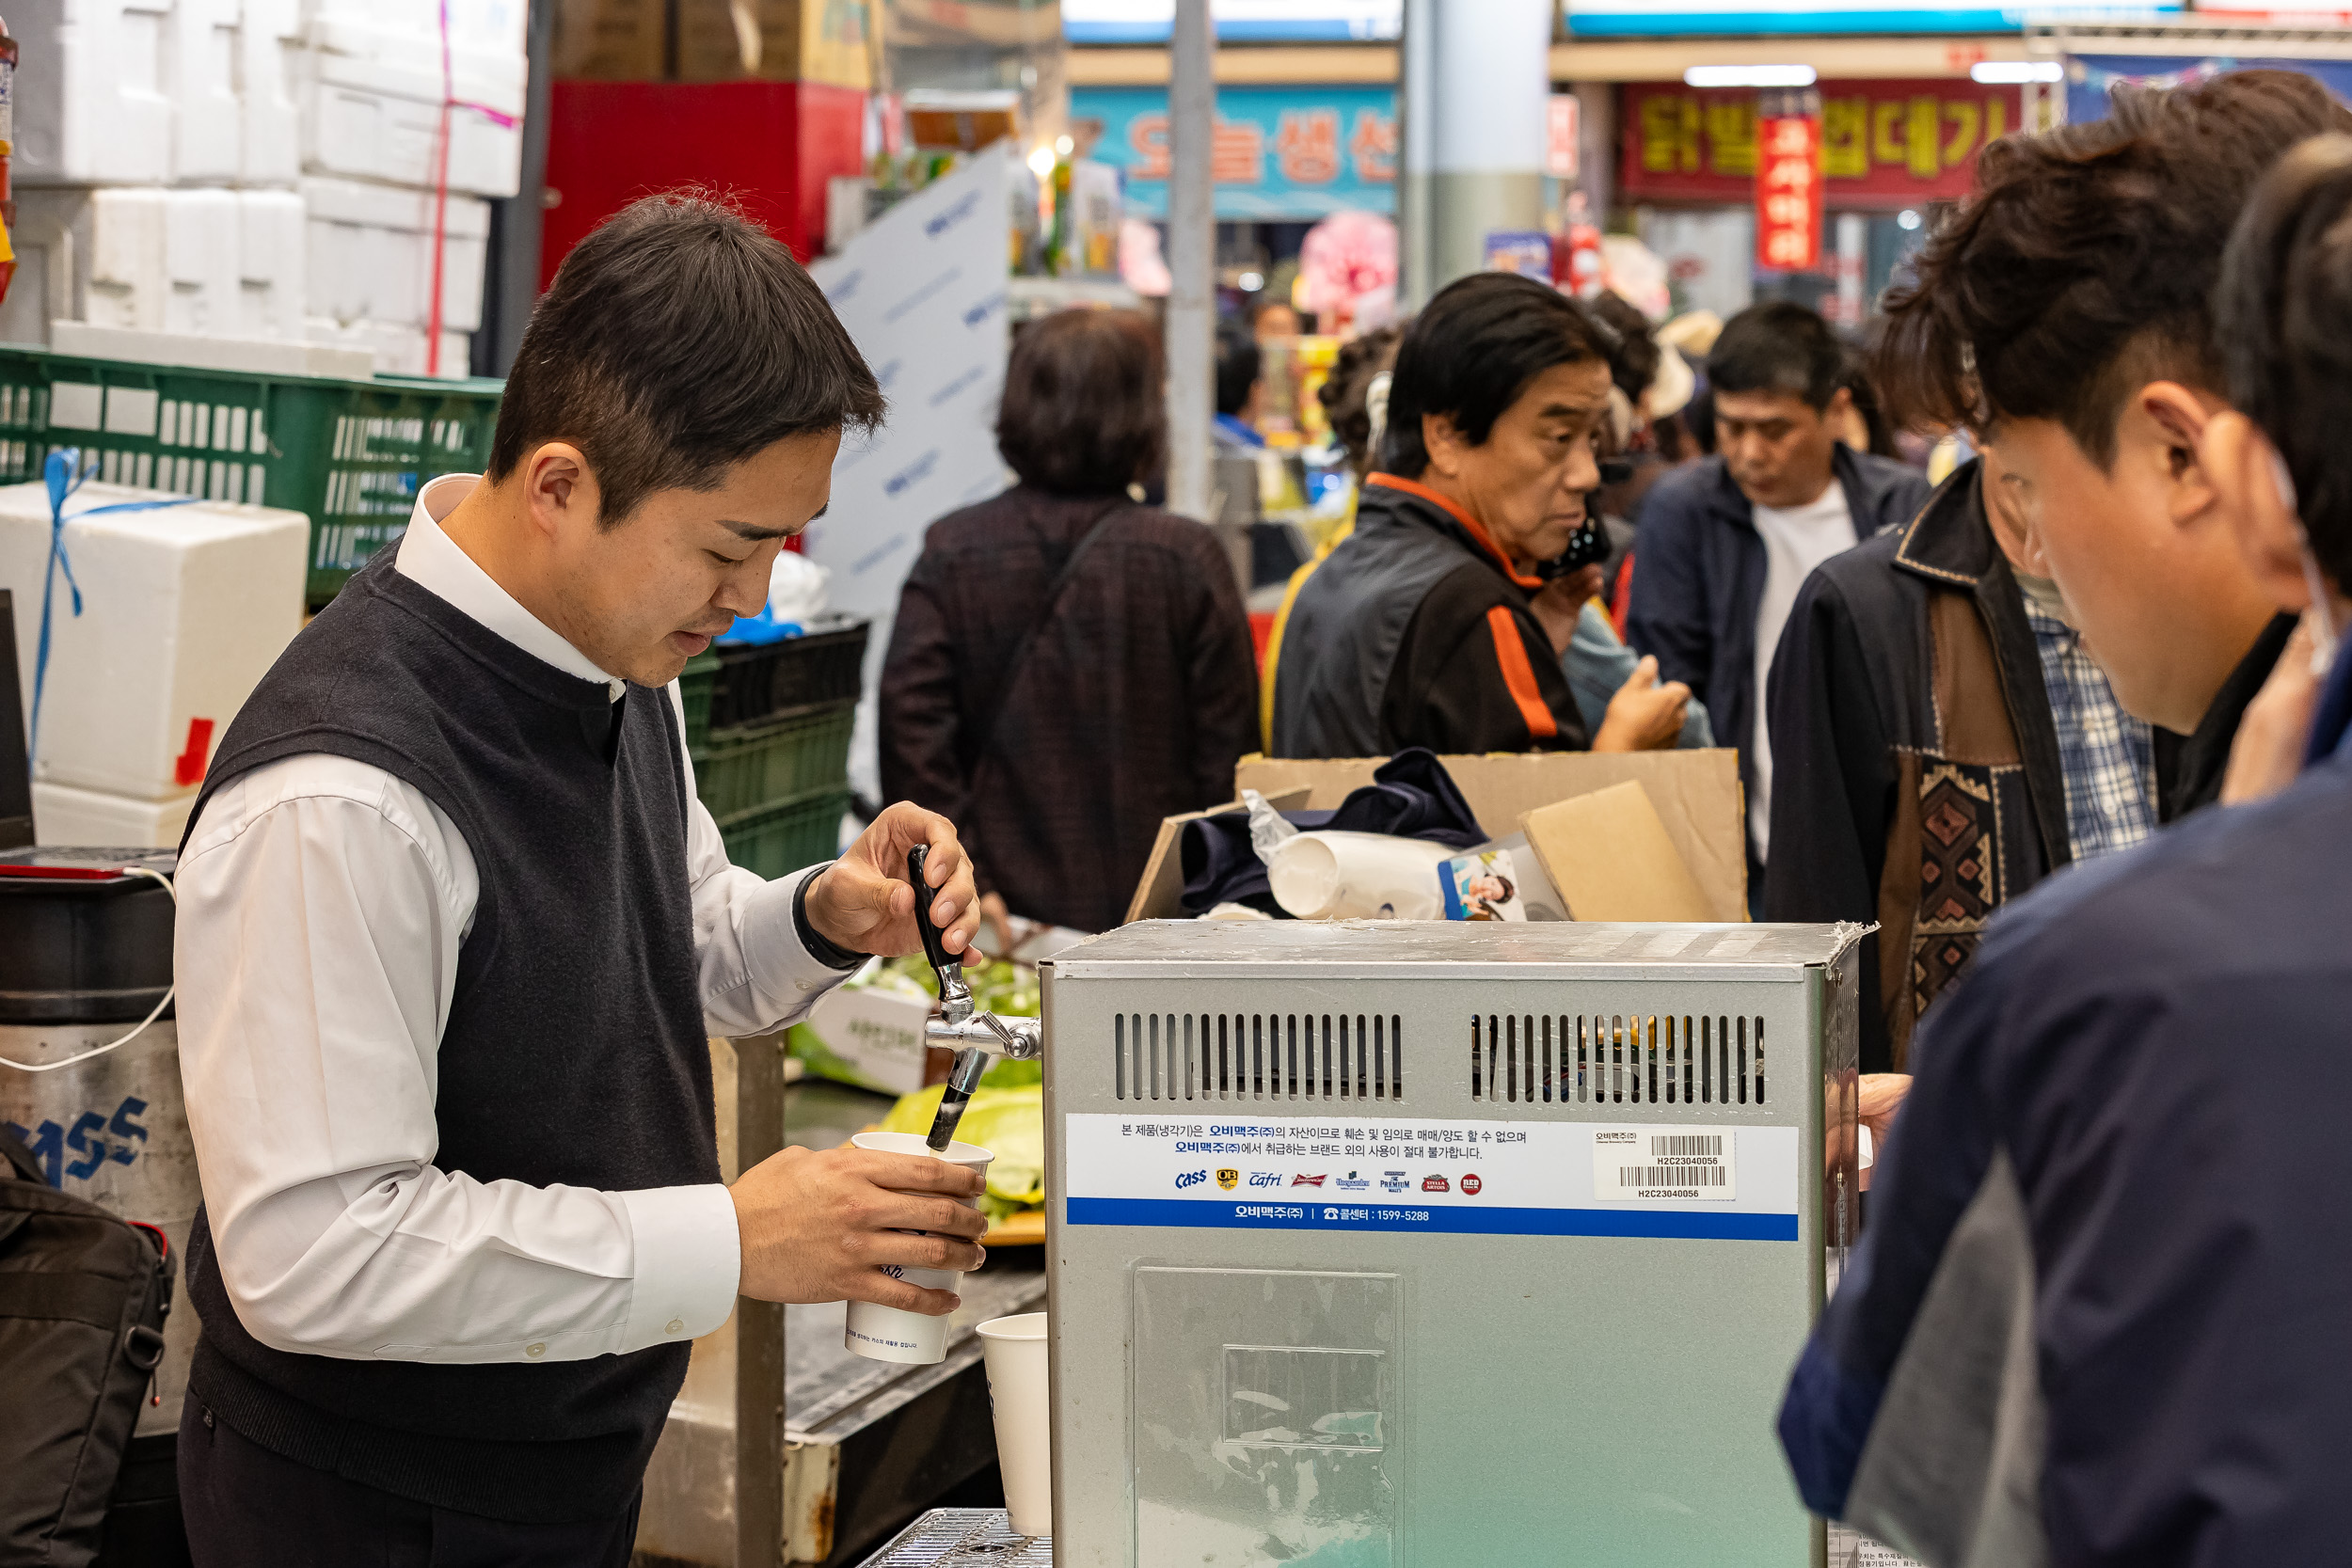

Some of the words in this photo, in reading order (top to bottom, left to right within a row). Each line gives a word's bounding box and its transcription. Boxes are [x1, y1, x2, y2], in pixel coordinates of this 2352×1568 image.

[1121, 1123, 1133, 1136] 본
[1135, 1124, 1204, 1138] 제품(냉각기)은
[1209, 1125, 1285, 1138] 오비맥주(주)의
[1287, 1126, 1342, 1139] 자산이므로
[1343, 1128, 1365, 1141] 훼손
[1368, 1128, 1378, 1141] 및
[1381, 1128, 1414, 1141] 임의로
[1417, 1129, 1464, 1142] 매매/양도
[1466, 1130, 1478, 1143] 할
[1481, 1131, 1492, 1143] 수
[1495, 1131, 1527, 1144] 없으며
[1595, 1132, 1637, 1140] 오비맥주(주)
[3, 1096, 149, 1192] ass
[1175, 1141, 1262, 1155] 오비맥주(주)에서
[1264, 1142, 1307, 1156] 취급하는
[1310, 1144, 1342, 1157] 브랜드
[1344, 1144, 1365, 1157] 외의
[1368, 1145, 1400, 1158] 사용이
[1404, 1146, 1424, 1159] 절대
[1427, 1146, 1483, 1160] 불가합니다.
[1657, 1157, 1718, 1166] H2C23040056
[1216, 1170, 1238, 1180] OB
[1248, 1172, 1282, 1189] Cafri
[1380, 1180, 1410, 1189] PREMIUM
[1638, 1190, 1699, 1198] H2C23040056
[1234, 1205, 1304, 1219] 오비맥주(주)
[1340, 1209, 1369, 1221] 콜센터
[1376, 1210, 1429, 1222] 1599-5288
